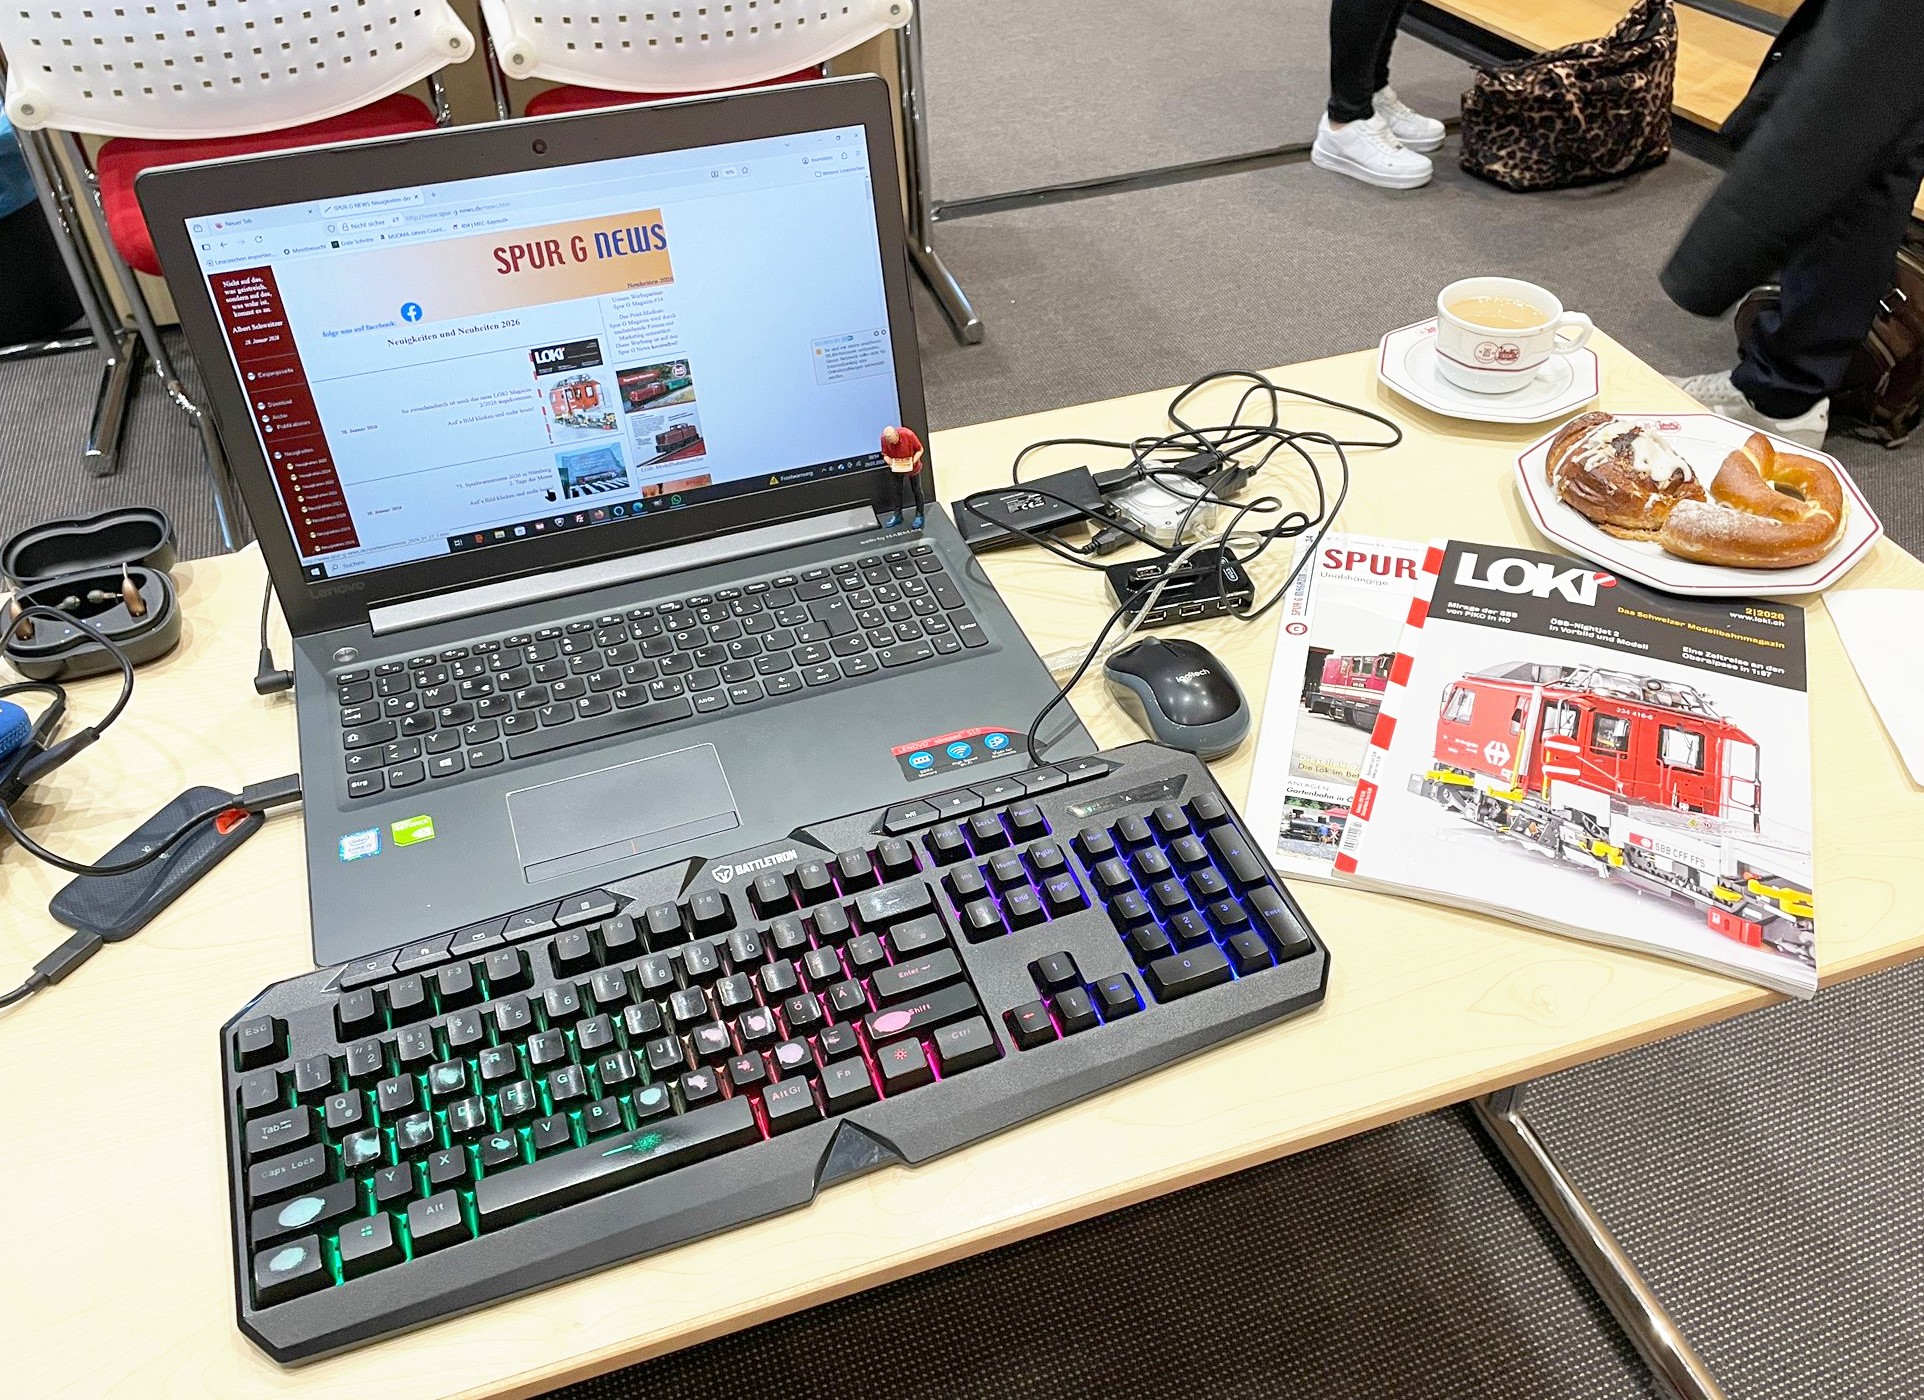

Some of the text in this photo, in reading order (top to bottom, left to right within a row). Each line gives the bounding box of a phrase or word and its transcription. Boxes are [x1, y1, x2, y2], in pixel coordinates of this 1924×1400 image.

[368, 219, 385, 227] sicher
[493, 223, 667, 274] SPUR G NEWS
[222, 280, 240, 288] Nicht
[251, 321, 283, 330] Schweitzer
[387, 319, 520, 347] Neuigkeiten und Neuheiten 2026
[1322, 548, 1418, 580] SPUR
[1454, 551, 1600, 607] LOKI
[311, 582, 366, 599] Lenovo
[1446, 608, 1463, 616] von
[1448, 601, 1480, 613] Mirage
[1481, 606, 1498, 615] der
[1729, 611, 1785, 627] www.loki.ch
[1550, 617, 1612, 636] ÖBB-Nightjet
[1617, 606, 1785, 649] Das Schweizer Modellbahnmagazin
[1549, 624, 1649, 650] in Vorbild und Modell
[1682, 646, 1785, 674] Eine Zeitreise an den
[1740, 665, 1750, 673] in
[1175, 668, 1210, 684] logitech
[1297, 763, 1312, 771] Die
[1287, 780, 1330, 791] ANLAGEN
[1286, 787, 1334, 800] Gartenbahn
[1655, 842, 1705, 868] SBB CFF FFS
[735, 849, 798, 875] BATTLETRON
[1014, 894, 1029, 902] End
[613, 982, 620, 991] 7
[564, 996, 572, 1005] 6
[516, 1010, 523, 1018] 5
[466, 1026, 474, 1035] 4
[417, 1041, 425, 1050] 3
[367, 1053, 375, 1063] 2
[261, 1124, 279, 1136] Tab
[290, 1156, 316, 1169] Lock
